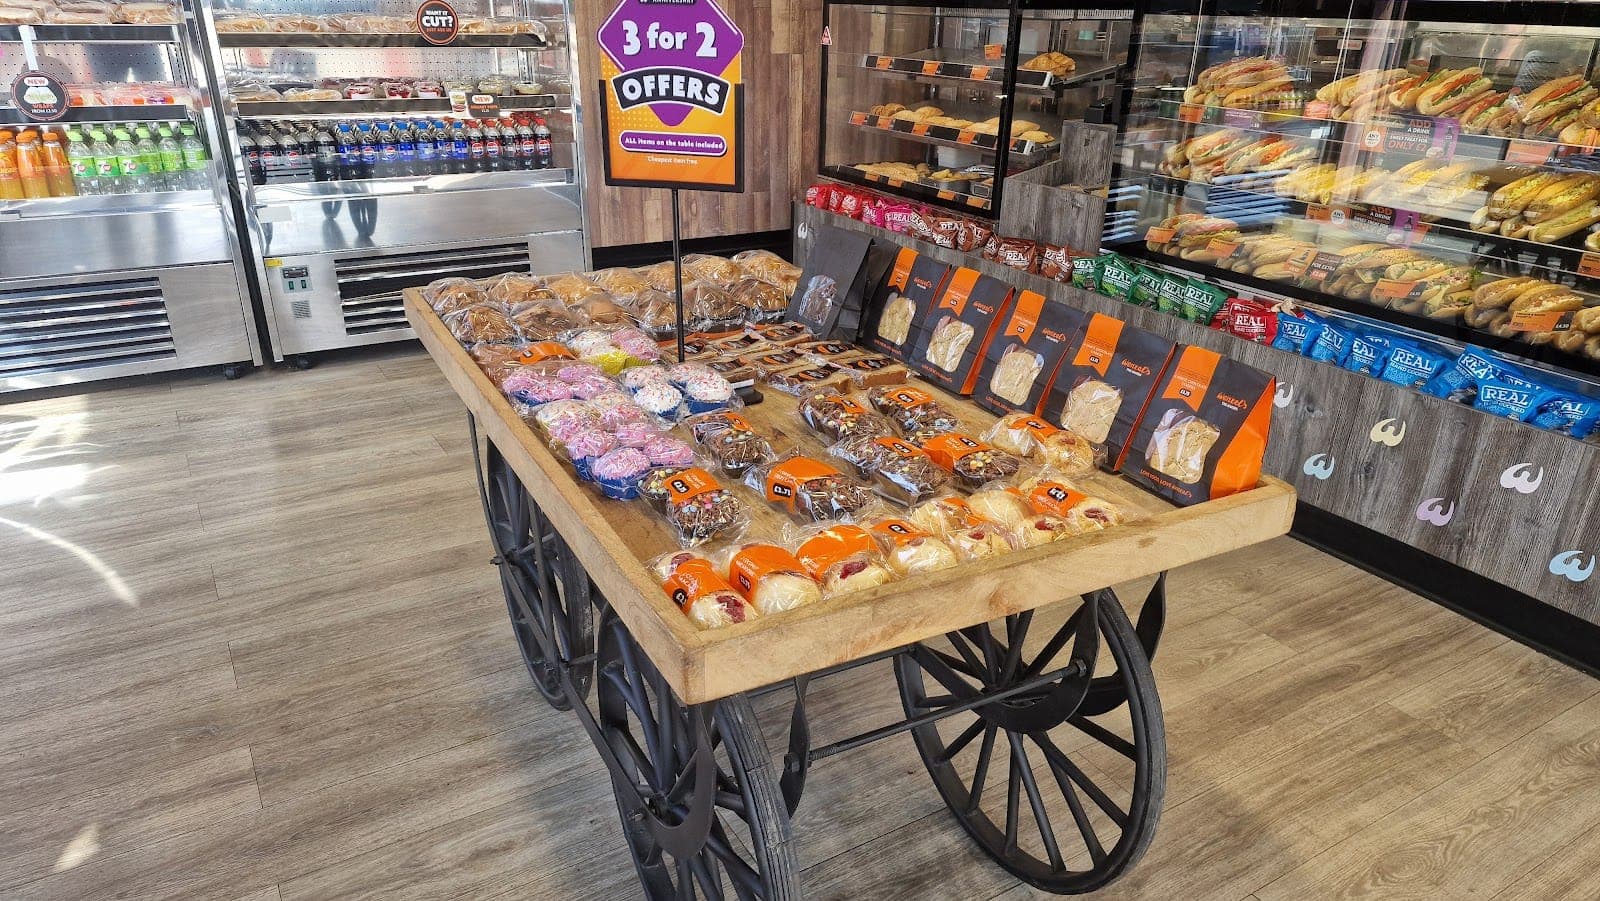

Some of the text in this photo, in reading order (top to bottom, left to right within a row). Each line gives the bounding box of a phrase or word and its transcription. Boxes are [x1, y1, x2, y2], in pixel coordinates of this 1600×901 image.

[422, 15, 453, 27] CUT?
[622, 20, 717, 58] 3 for 2
[622, 74, 721, 105] OFFERS
[1409, 119, 1432, 128] ADD
[666, 139, 676, 147] the
[695, 141, 723, 149] included
[1388, 141, 1415, 149] ONLY
[647, 156, 673, 164] Cheapest
[1371, 206, 1393, 215] ADD
[1104, 267, 1131, 283] REAL
[1163, 281, 1184, 299] REAL
[1186, 287, 1213, 305] REAL
[1235, 315, 1264, 326] REAL
[1353, 339, 1375, 358] EAL
[1394, 350, 1432, 371] REAL
[1391, 361, 1430, 379] HAND COOKED
[1485, 388, 1529, 406] REAL
